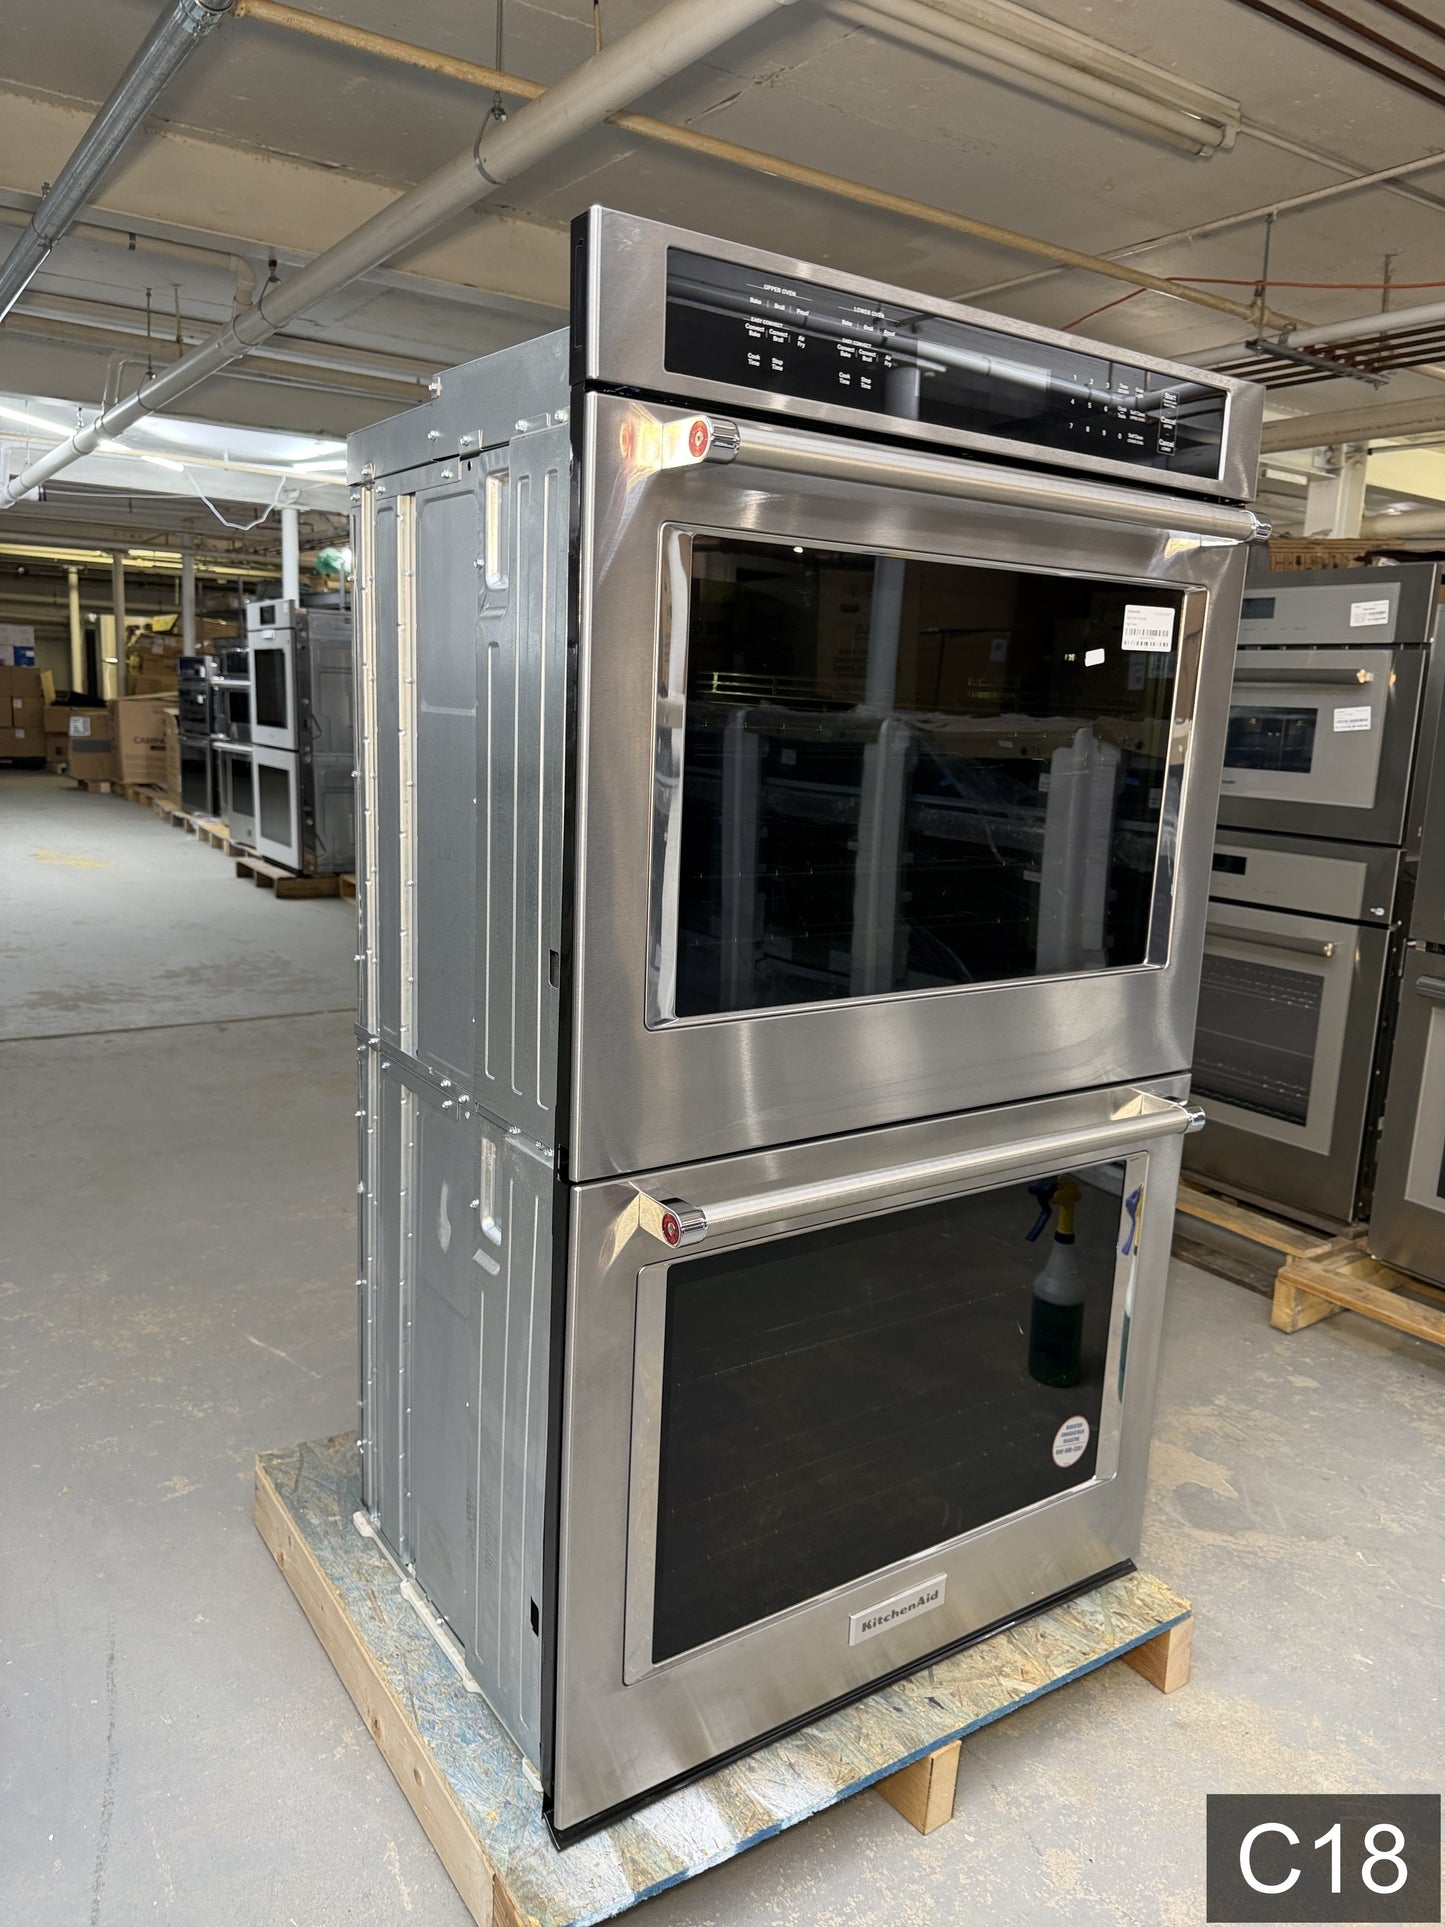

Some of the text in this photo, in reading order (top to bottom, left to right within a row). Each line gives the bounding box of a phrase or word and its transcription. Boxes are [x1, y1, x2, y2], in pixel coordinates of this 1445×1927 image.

[764, 284, 796, 297] UPPER OVEN
[854, 306, 871, 316] LOWER
[1160, 416, 1176, 425] Cancel
[1158, 439, 1174, 448] Cancel
[862, 1590, 939, 1632] KitchenAid
